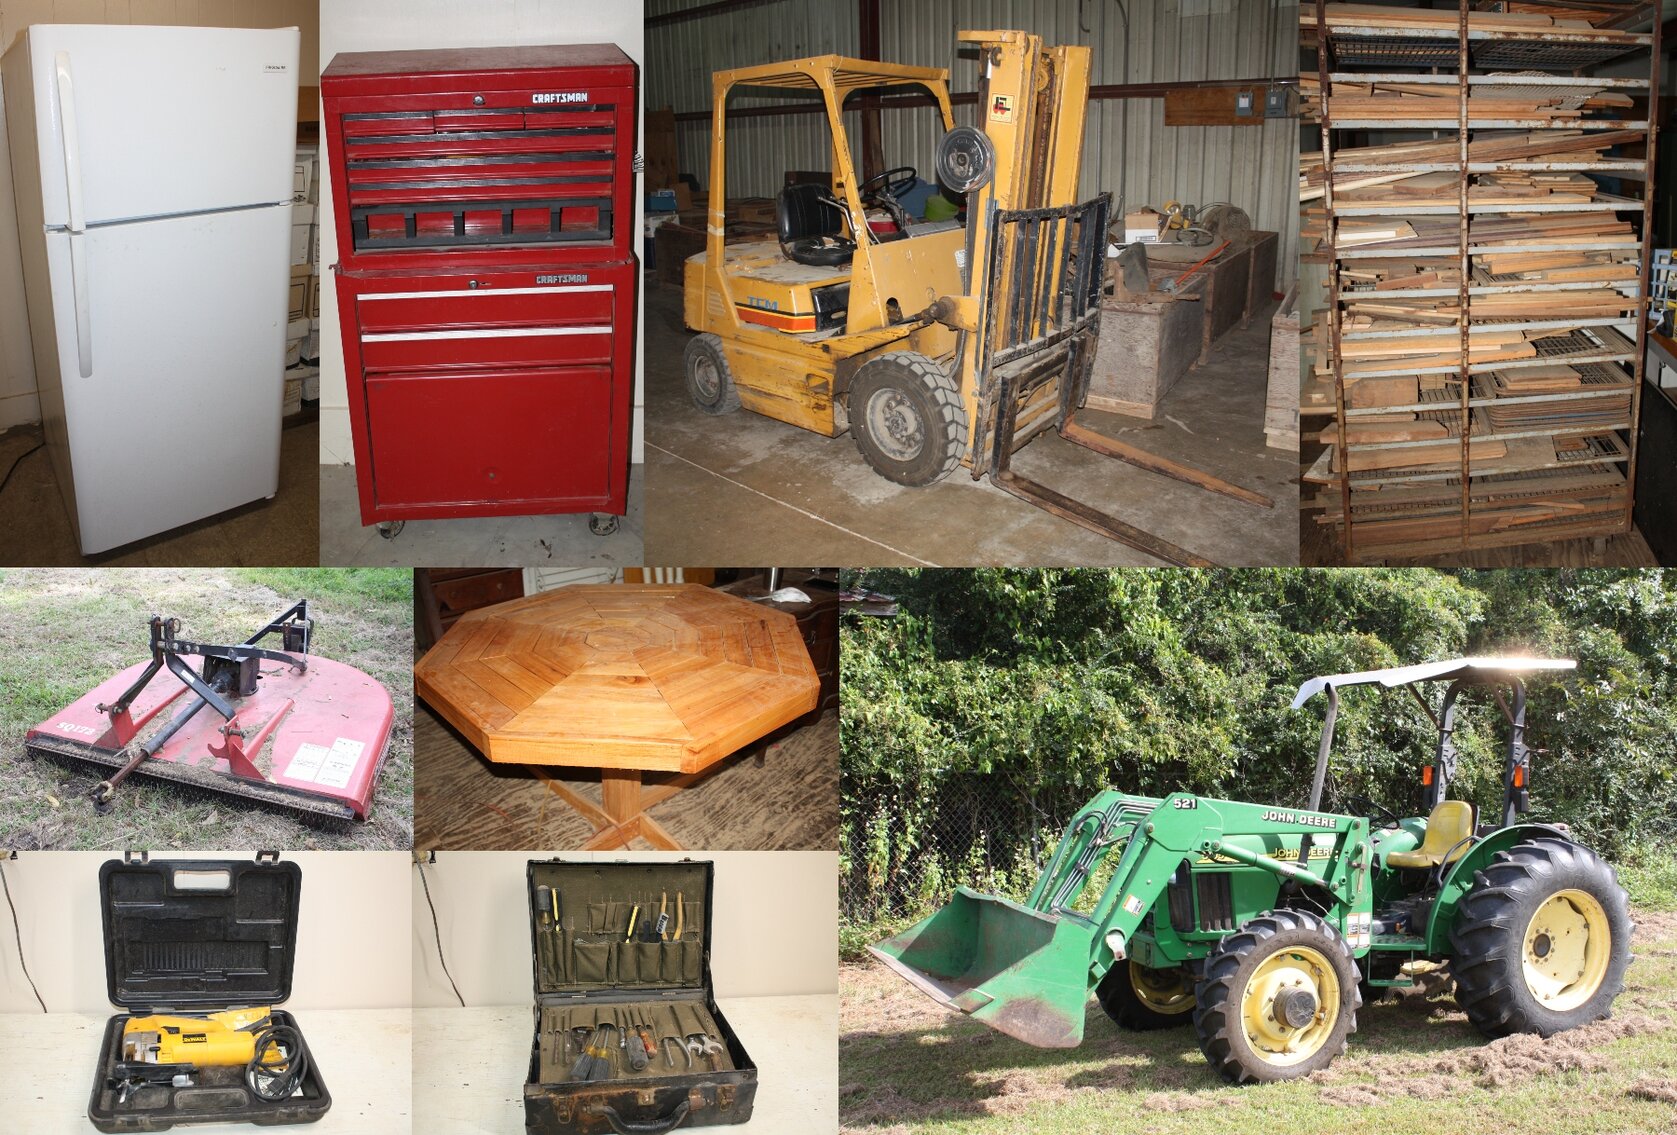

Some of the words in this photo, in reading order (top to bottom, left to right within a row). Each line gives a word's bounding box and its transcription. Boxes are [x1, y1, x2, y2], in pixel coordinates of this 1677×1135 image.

[532, 92, 588, 103] CRAFTSMAN
[536, 274, 588, 284] CRAFTSMAN
[1173, 798, 1198, 810] 521
[1261, 811, 1296, 824] JOHN
[1298, 815, 1337, 829] DEERE
[1272, 847, 1300, 860] JOHN
